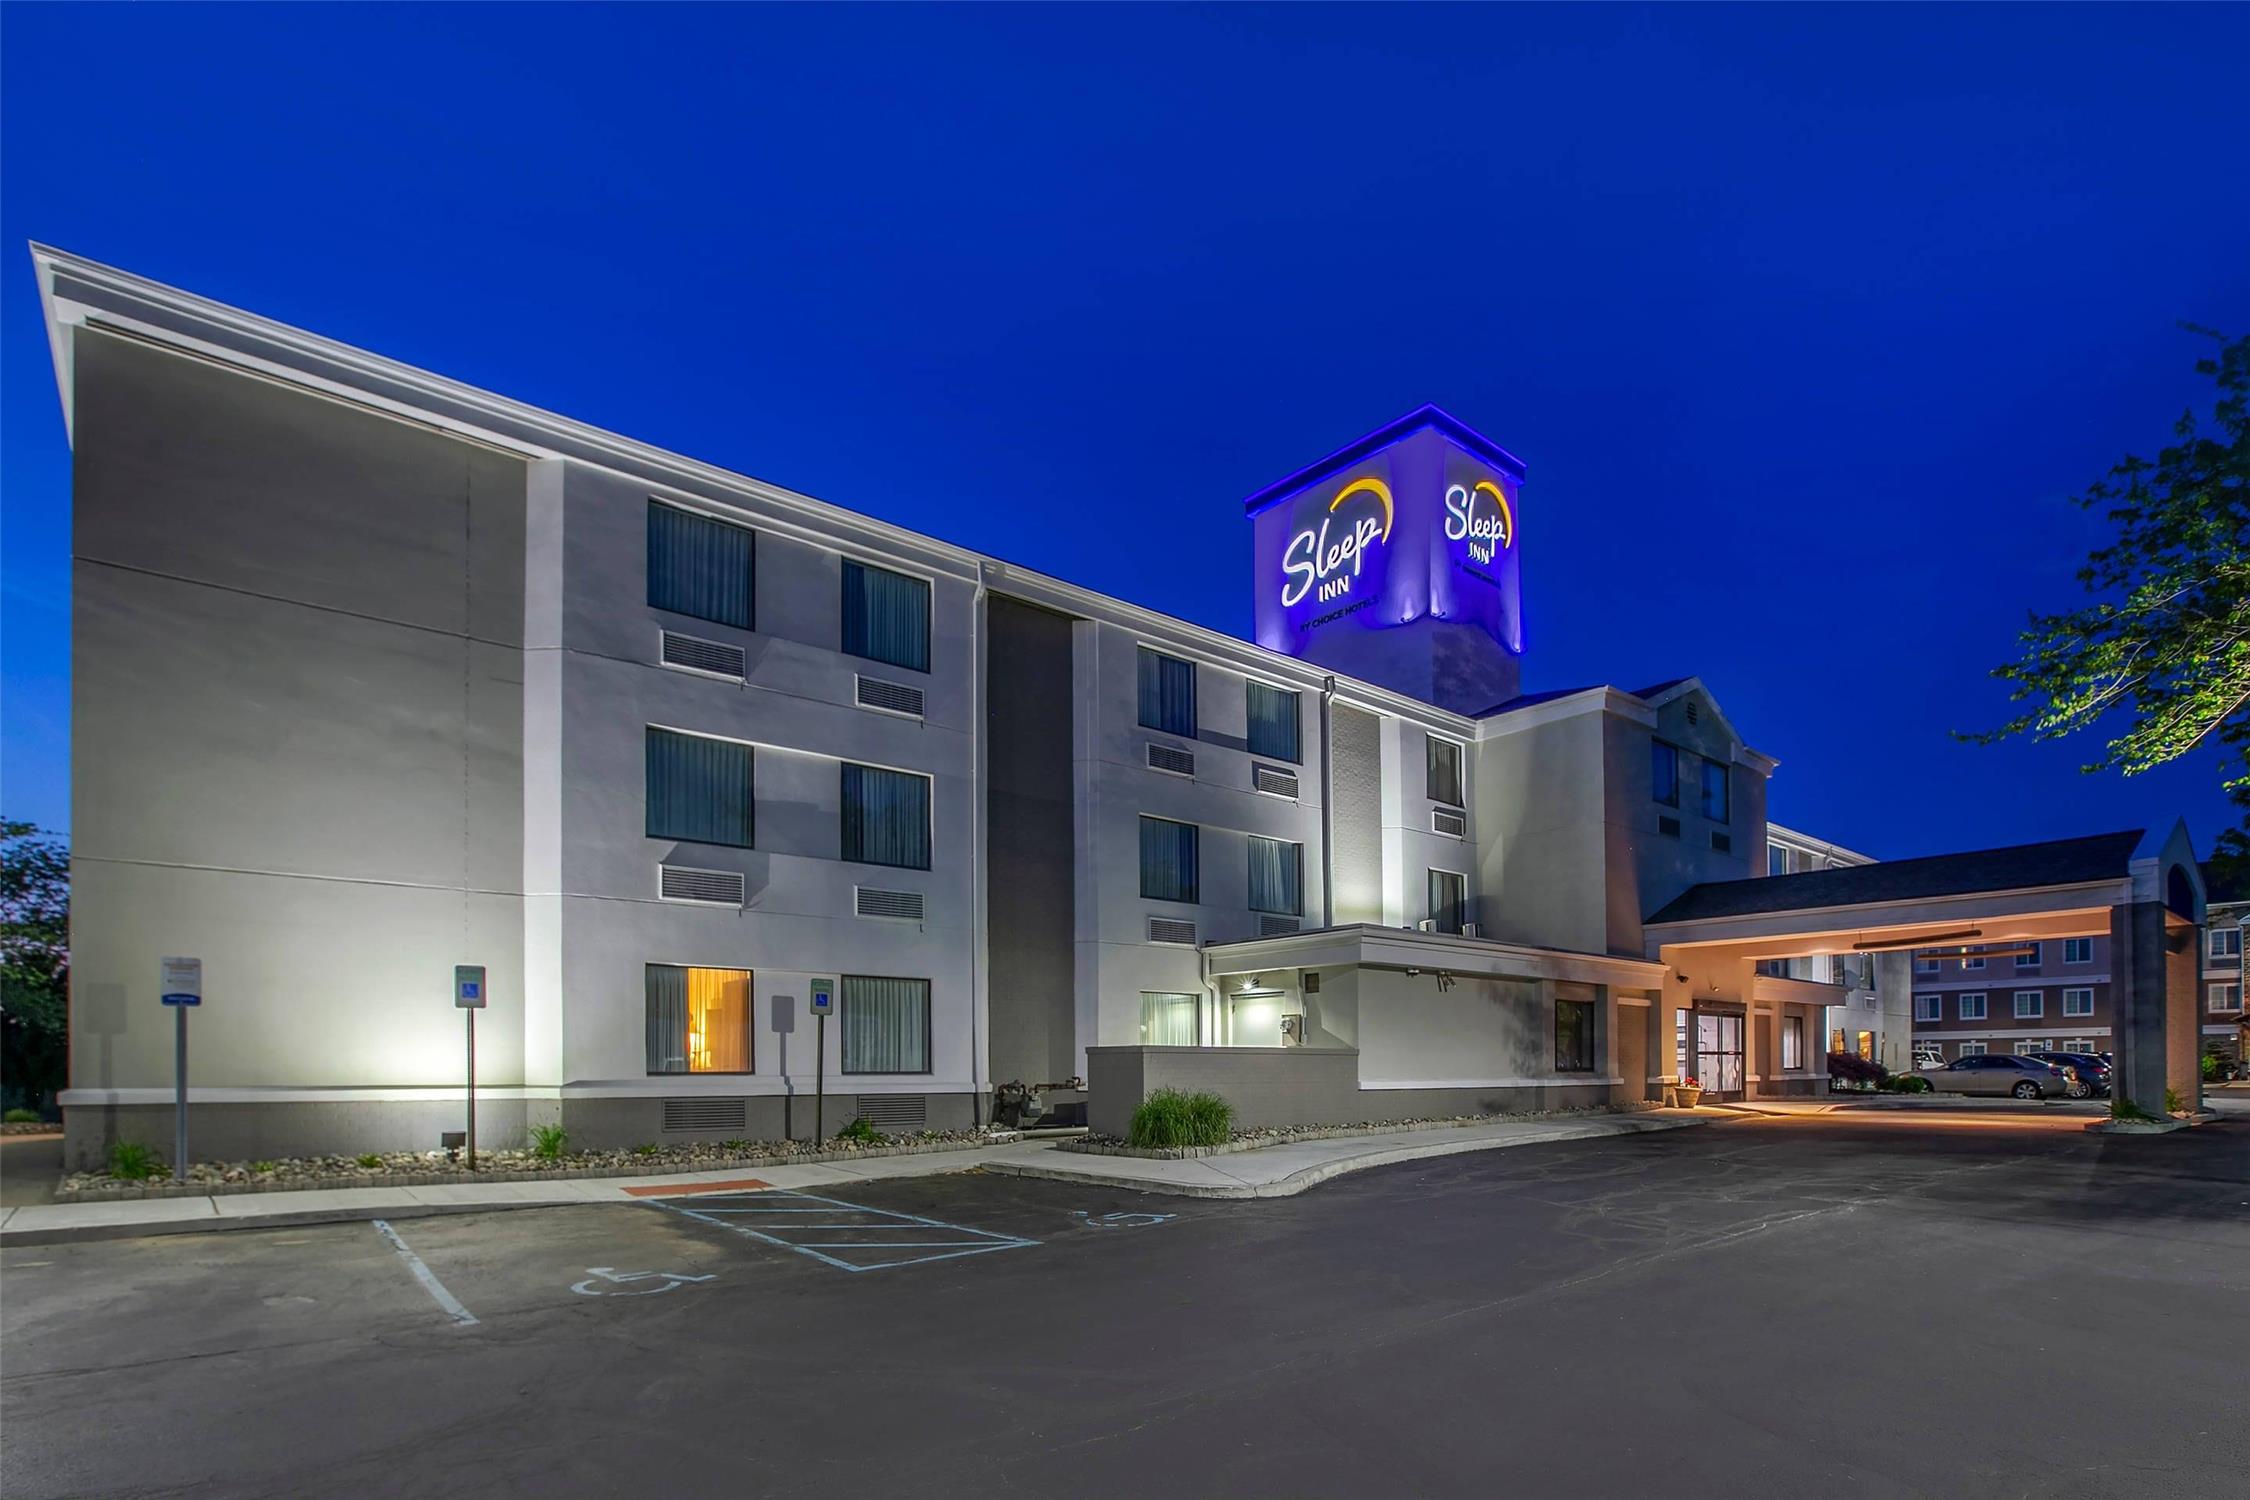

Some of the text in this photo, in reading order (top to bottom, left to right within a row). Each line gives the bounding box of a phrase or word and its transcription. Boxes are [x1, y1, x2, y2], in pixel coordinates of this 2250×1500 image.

[1445, 484, 1506, 558] Sleep
[1281, 517, 1383, 607] Sleep
[1468, 542, 1490, 565] INN
[1318, 575, 1350, 603] INN
[1311, 609, 1344, 629] CHOICE
